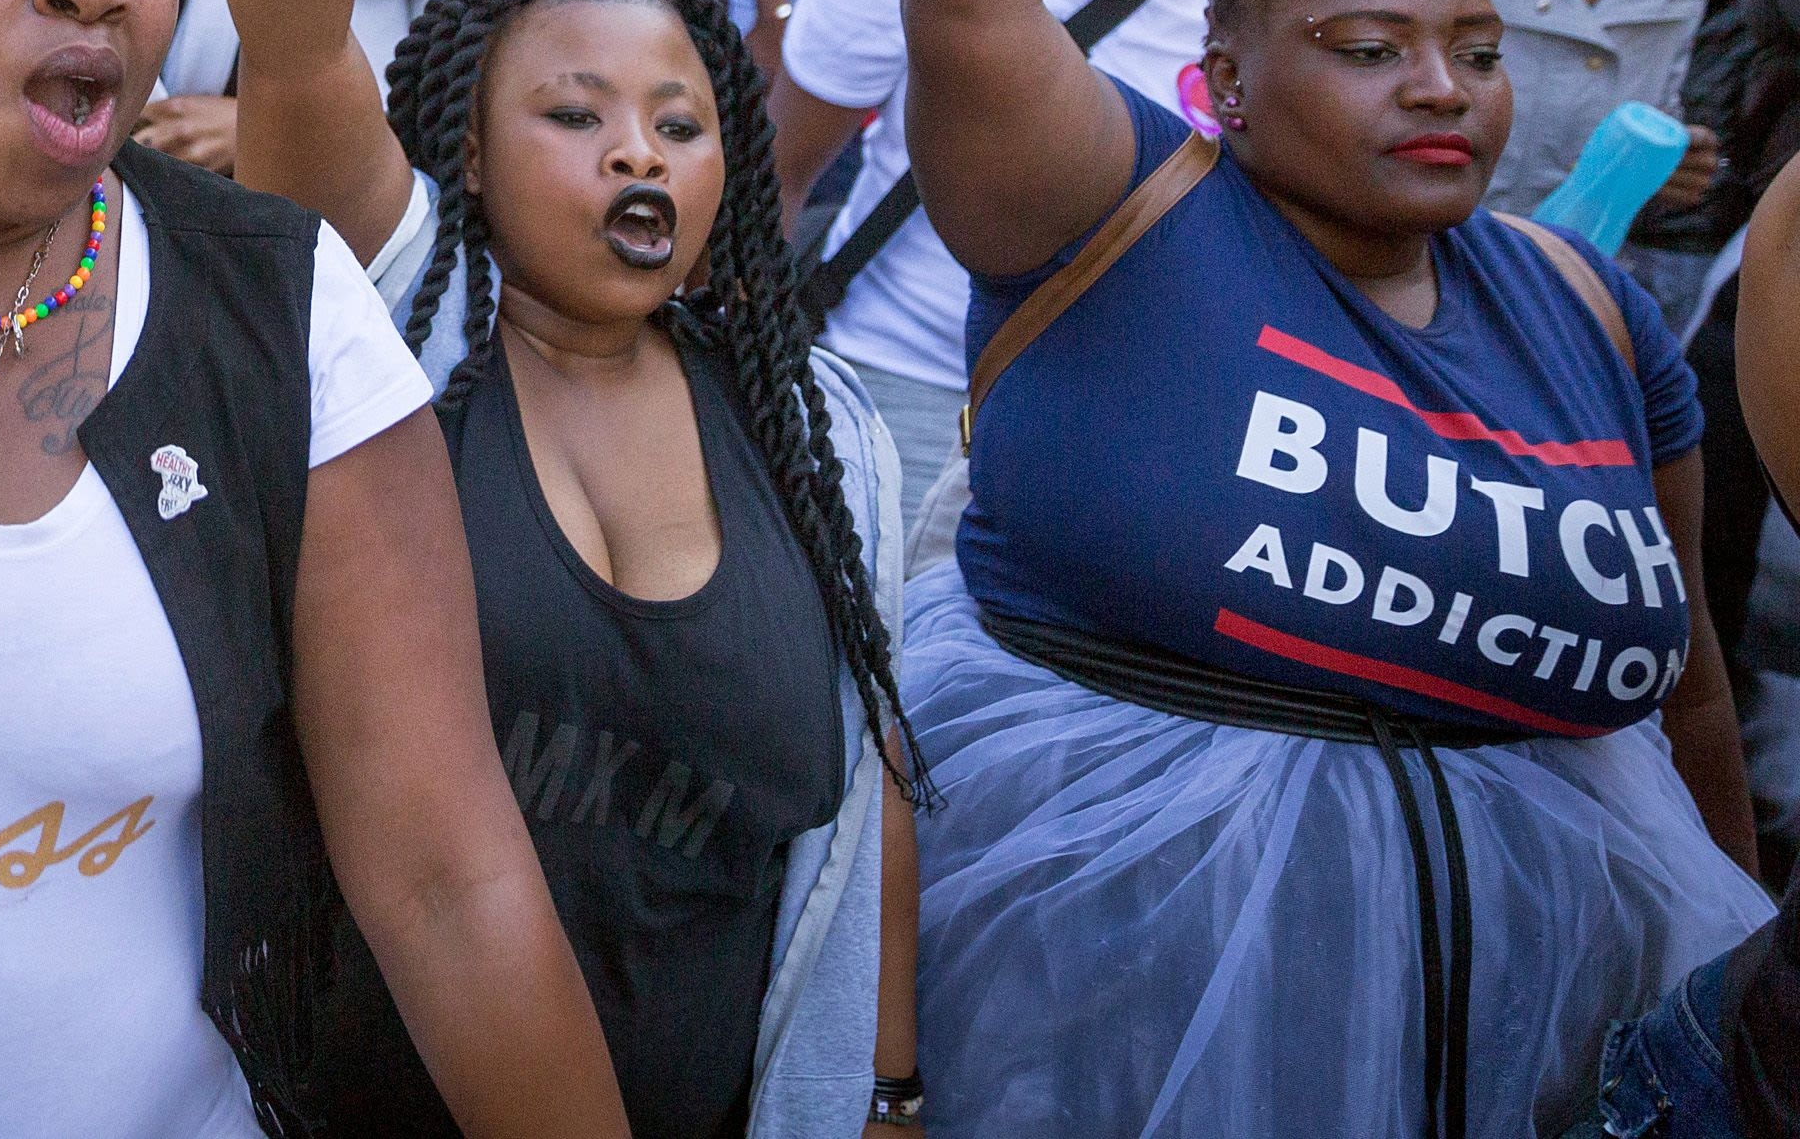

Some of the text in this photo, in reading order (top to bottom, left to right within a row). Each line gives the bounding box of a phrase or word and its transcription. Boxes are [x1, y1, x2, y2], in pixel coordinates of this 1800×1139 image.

[155, 452, 192, 477] HEALTHY
[167, 473, 193, 493] SEXY
[1235, 390, 1687, 609] BUTCH
